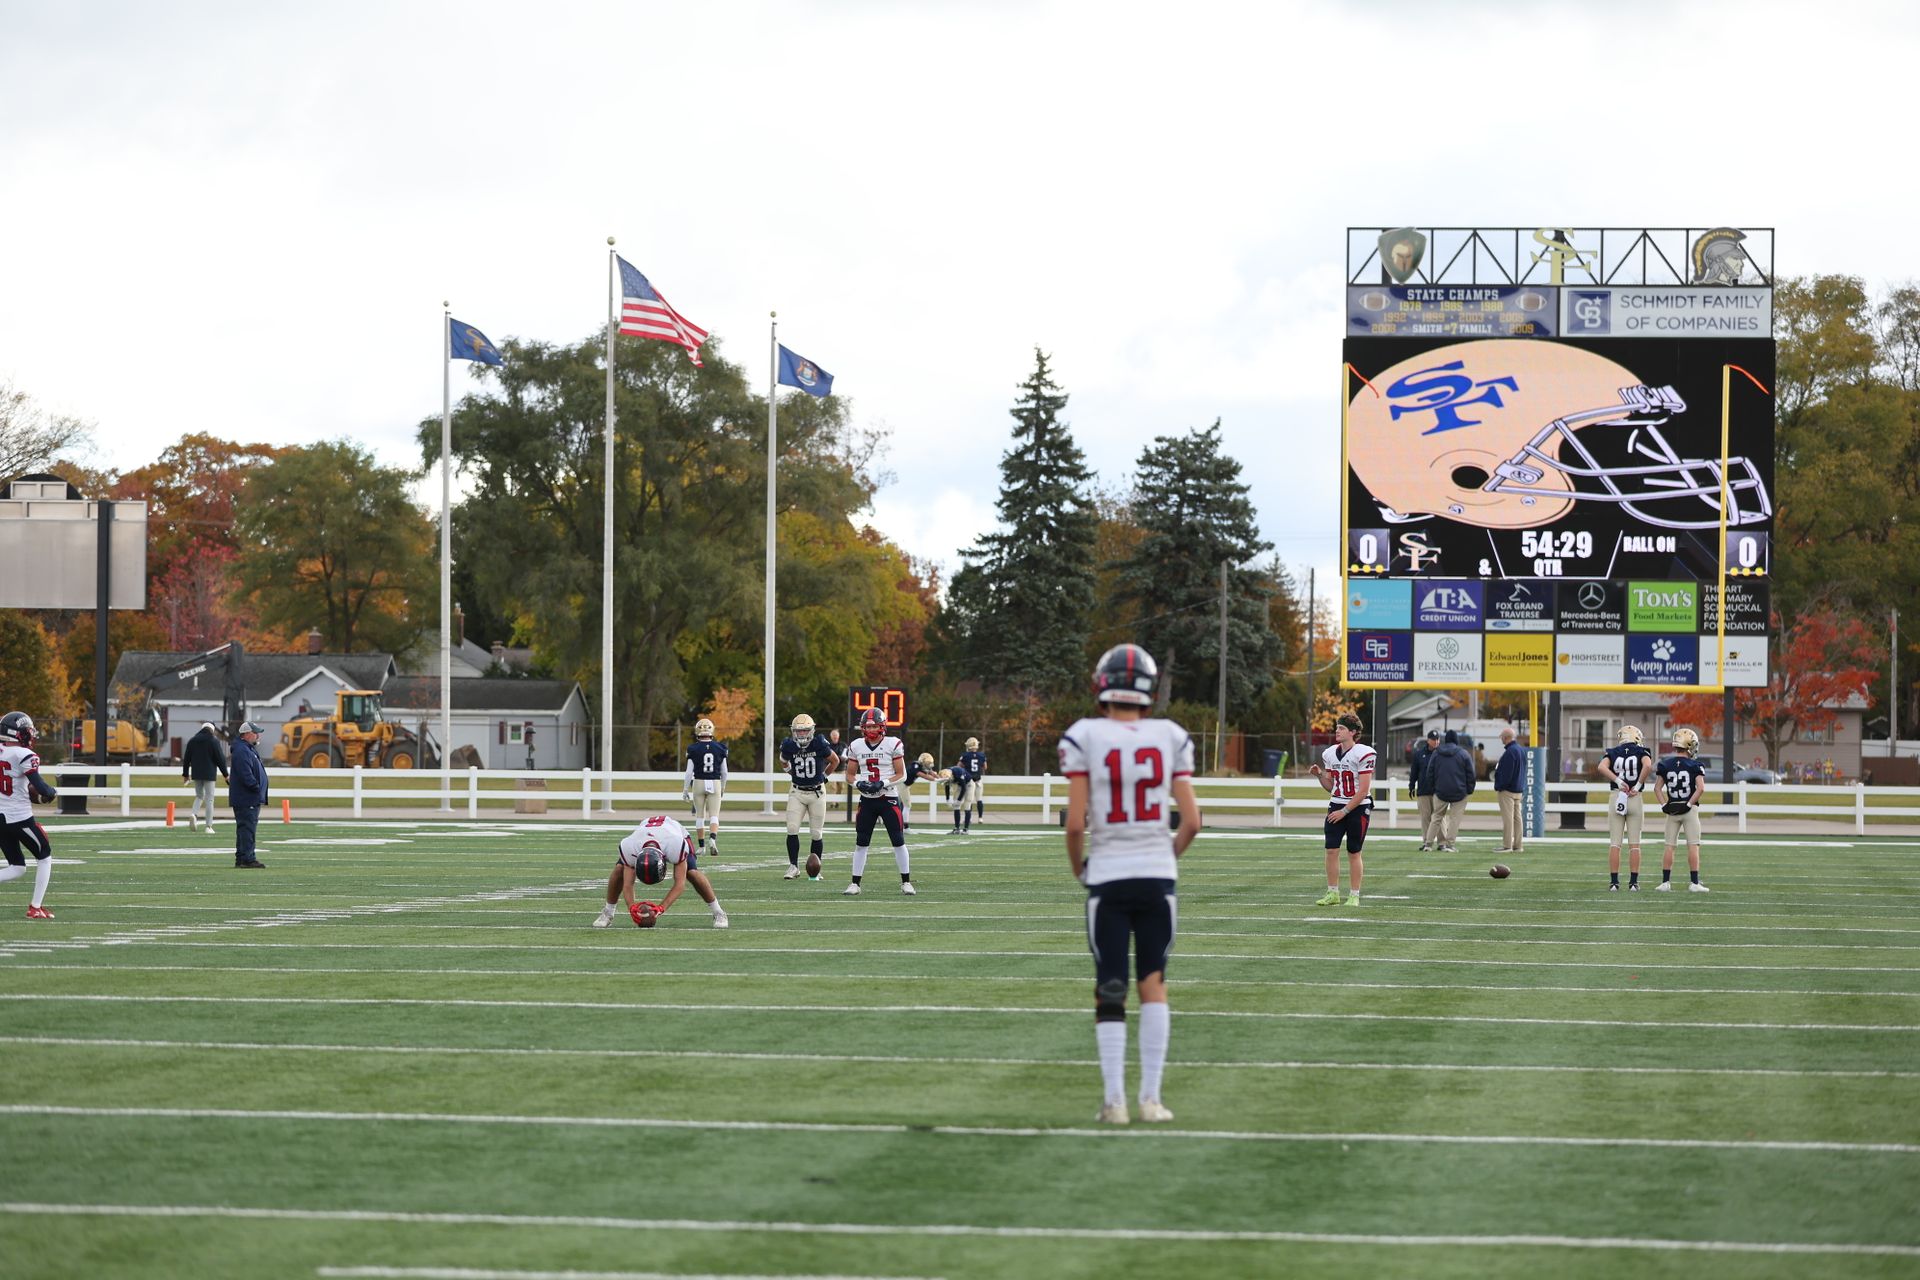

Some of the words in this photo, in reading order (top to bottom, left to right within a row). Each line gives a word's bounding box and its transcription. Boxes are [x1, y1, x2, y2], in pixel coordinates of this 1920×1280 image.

[1407, 289, 1445, 300] STATE
[1449, 289, 1499, 300] CHAMPS
[1620, 295, 1697, 309] SCHMIDT
[1703, 295, 1764, 309] FAMILY
[1412, 324, 1442, 334] SMITH
[1459, 324, 1492, 334] FAMILY
[1626, 316, 1650, 330] OF
[1656, 316, 1758, 330] COMPANIES
[1359, 534, 1378, 564] 0
[1521, 531, 1593, 558] 54:29
[1623, 536, 1654, 552] BALL
[1656, 536, 1676, 552] ON
[1738, 536, 1758, 568] 0
[1478, 559, 1492, 576] &
[1533, 559, 1563, 577] QTR
[1725, 585, 1742, 593] ART
[1496, 602, 1512, 610] FOX
[1514, 602, 1544, 610] GRAND
[1704, 604, 1762, 612] SCMUCKAL
[1420, 614, 1447, 622] CREDIT
[1448, 614, 1476, 622] UNION
[1500, 611, 1540, 619] TRAVERSE
[1561, 612, 1620, 620] Mercedes-Benz
[1633, 612, 1654, 620] Food
[1656, 612, 1692, 620] Markets
[1606, 621, 1622, 630] City
[1704, 622, 1764, 630] FONDATION
[1489, 652, 1522, 661] Edward
[1522, 652, 1549, 662] Jones
[178, 664, 207, 680] DEERE
[1372, 662, 1408, 672] TRAVERSE
[1418, 662, 1478, 672] PERENNIAL
[1630, 658, 1662, 674] happy
[1666, 661, 1693, 674] paws
[1350, 672, 1404, 680] CONSTRUCTION
[855, 690, 904, 726] 40
[703, 752, 715, 774] 8
[794, 757, 816, 778] 20
[866, 758, 880, 782] 5
[970, 759, 979, 772] 5
[1613, 756, 1638, 781] 40
[1104, 747, 1163, 823] 12
[1666, 770, 1691, 798] 23
[1526, 751, 1534, 838] GLADIATORS
